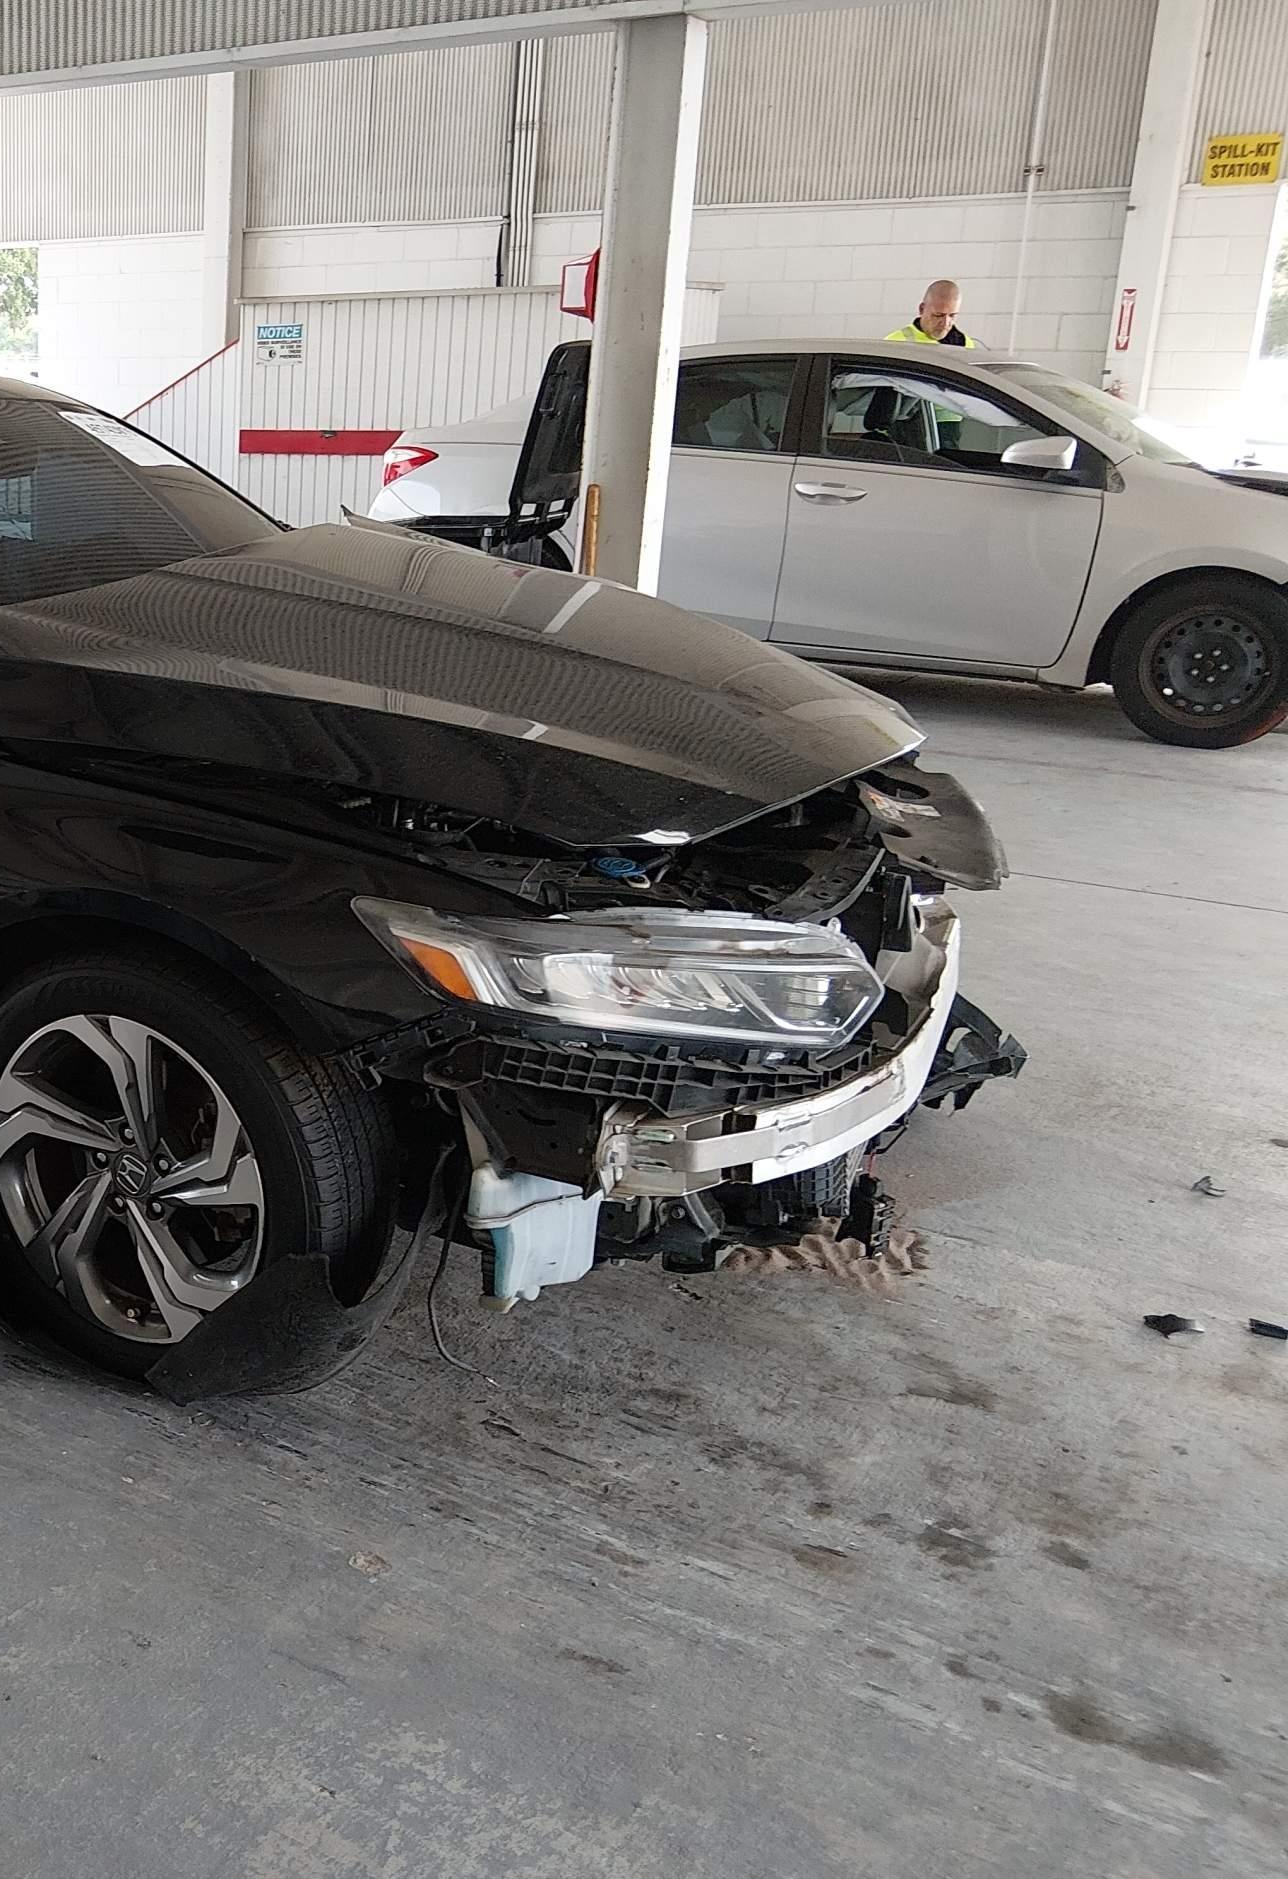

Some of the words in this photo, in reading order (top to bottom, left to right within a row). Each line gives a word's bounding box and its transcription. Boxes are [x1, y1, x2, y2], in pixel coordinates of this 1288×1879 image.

[1208, 142, 1280, 159] SPILL-KIT
[1210, 162, 1271, 178] STATION
[258, 326, 301, 338] NOTICE
